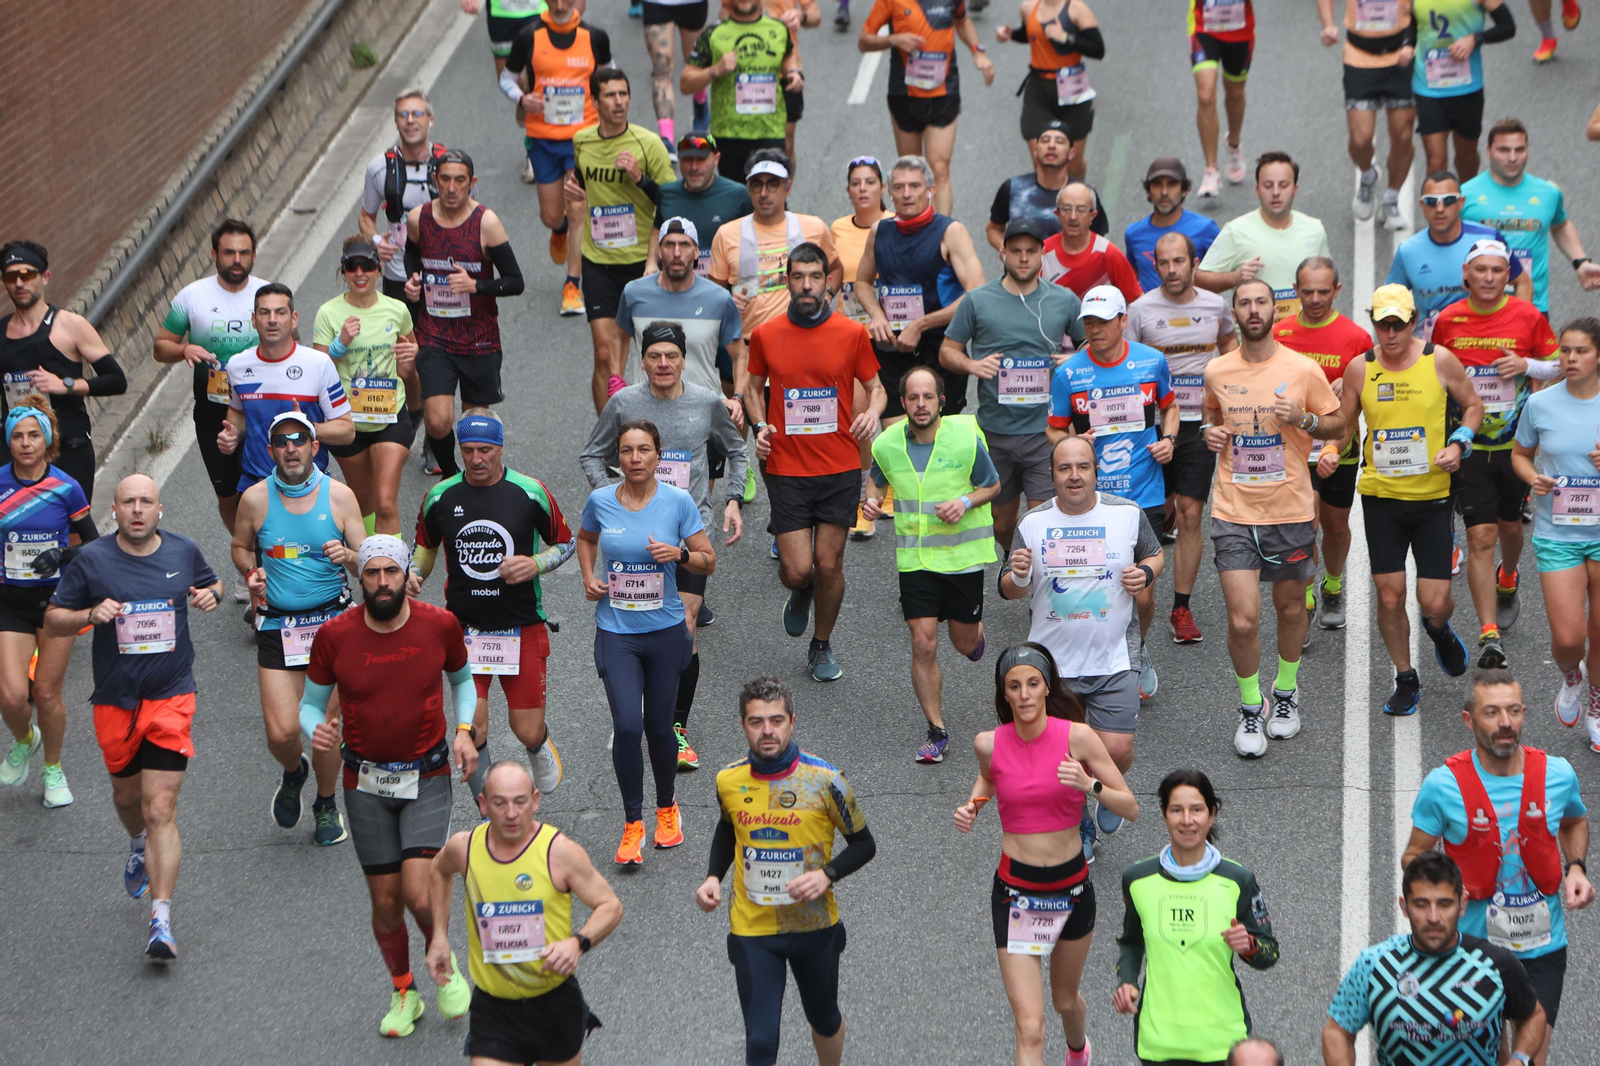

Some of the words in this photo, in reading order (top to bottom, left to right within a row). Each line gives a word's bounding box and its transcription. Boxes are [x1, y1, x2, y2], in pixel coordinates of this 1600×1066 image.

[586, 166, 626, 183] MIUT
[604, 206, 629, 215] ZURICH
[891, 287, 917, 295] ZURICH
[1016, 360, 1045, 368] ZURICH
[1075, 366, 1094, 375] pyxis
[1174, 377, 1202, 385] ZURICH
[802, 390, 831, 398] ZURICH
[1105, 387, 1135, 396] ZURICH
[1106, 403, 1125, 412] 8079
[1257, 405, 1276, 413] Sevill
[1107, 415, 1127, 423] JORGE
[1246, 438, 1276, 446] ZURICH
[661, 451, 685, 460] URICH
[1246, 453, 1266, 461] 7930
[1097, 479, 1131, 489] SOLER
[1570, 494, 1590, 502] 7877
[21, 533, 53, 541] ZURICH
[1066, 529, 1100, 537] ZURICH
[455, 538, 503, 549] Donando
[1066, 545, 1086, 553] 7264
[457, 549, 503, 564] Vidas
[1065, 557, 1088, 565] TOMÁS
[471, 588, 500, 596] mobel
[613, 591, 633, 599] CARLA
[135, 602, 168, 611] ZURICH
[136, 620, 157, 628] 7096
[133, 633, 162, 641] VINCENT
[300, 632, 317, 641] 674
[760, 851, 796, 860] ZURICH
[760, 869, 782, 879] 9427
[498, 903, 536, 914] ZURICH
[1033, 901, 1068, 910] ZURICH
[1032, 917, 1054, 927] 7728
[1508, 913, 1535, 925] 10072
[1034, 933, 1051, 941] TUKI
